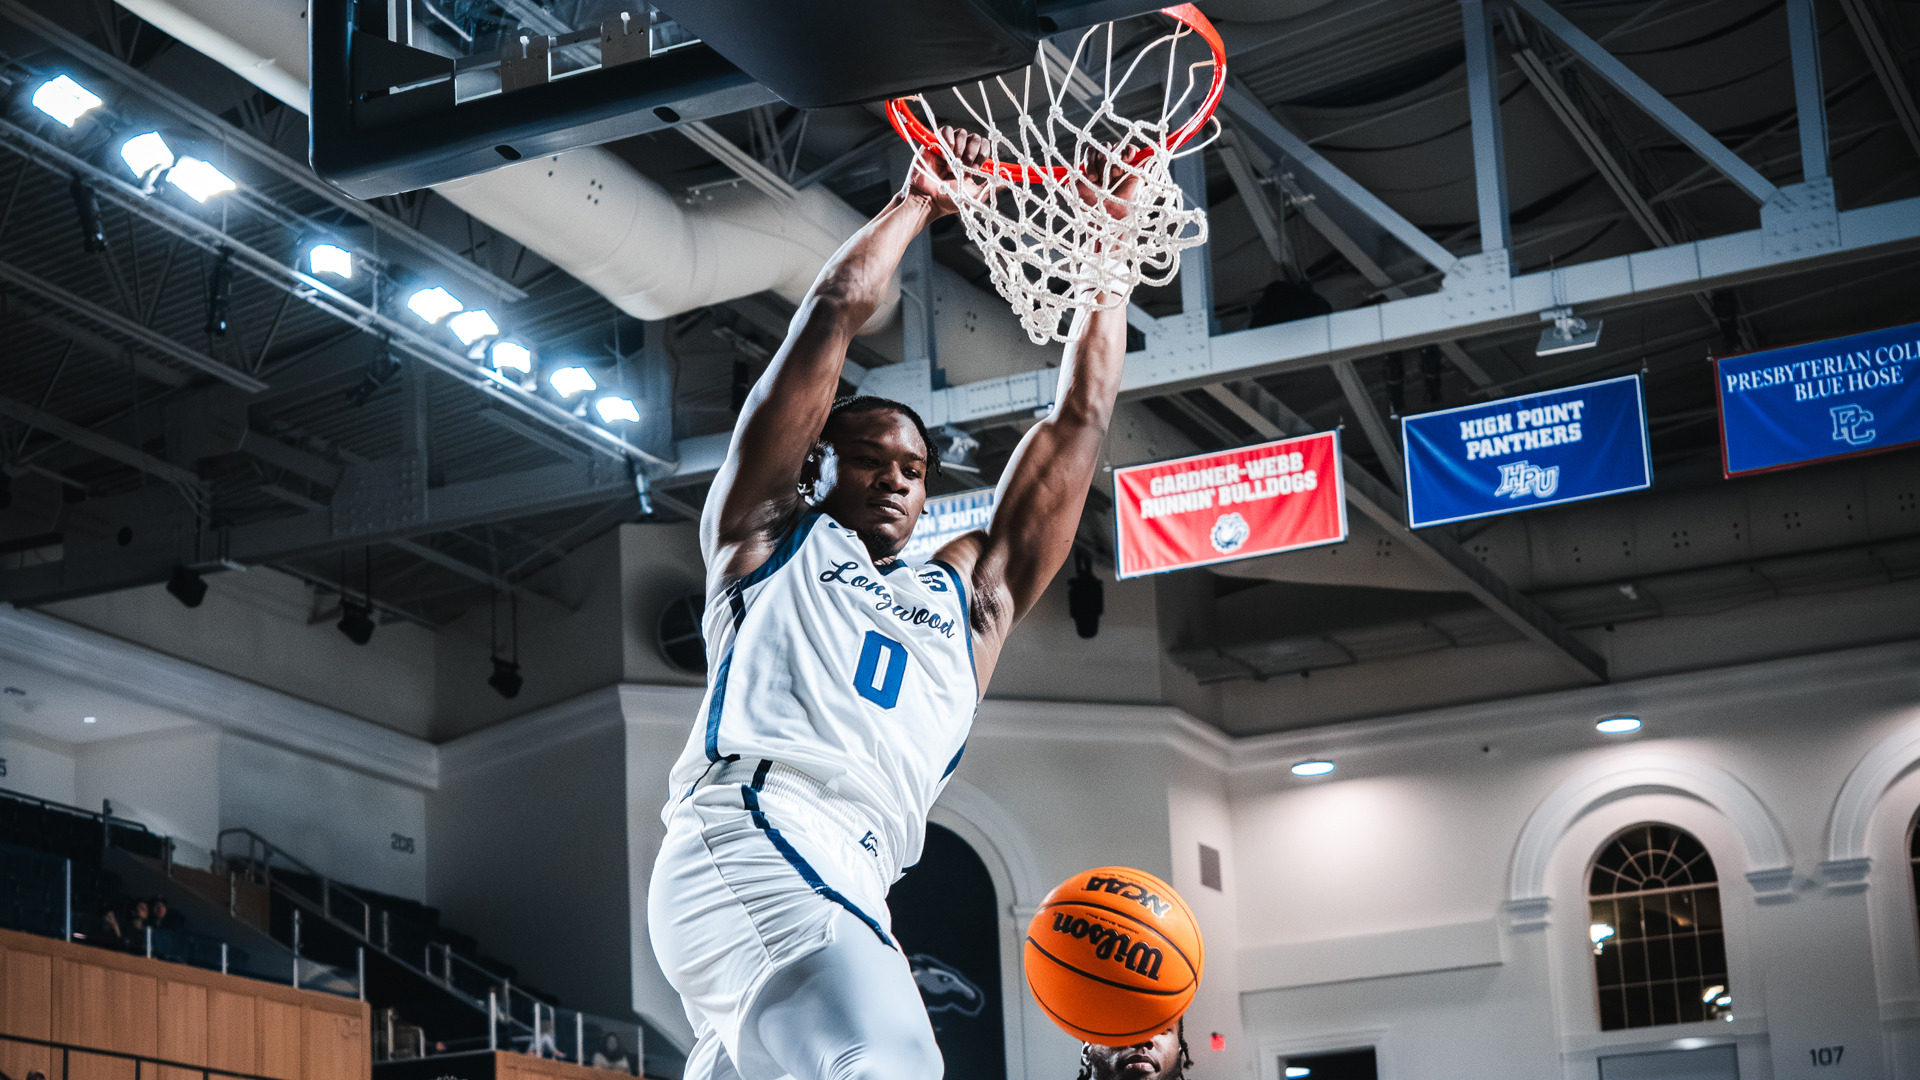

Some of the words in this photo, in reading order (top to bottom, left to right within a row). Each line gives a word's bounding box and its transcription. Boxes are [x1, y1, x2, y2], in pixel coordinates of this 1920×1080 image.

[1726, 350, 1871, 393] PRESBYTERIAN
[1794, 376, 1845, 402] BLUE
[1848, 365, 1904, 392] HOSE
[1460, 413, 1513, 440] HIGH
[1516, 400, 1584, 430] POINT
[1466, 422, 1582, 460] PANTHERS
[1140, 488, 1216, 518] RUNNIN'
[1219, 470, 1318, 506] BULLDOGS
[1150, 452, 1303, 496] GARDNER-WEBB
[1494, 460, 1560, 499] HPU
[913, 514, 936, 535] ON
[820, 559, 955, 638] Longwood
[853, 630, 908, 710] 0
[1085, 876, 1173, 919] NCAA
[1052, 912, 1163, 982] Wilson
[1810, 1046, 1844, 1067] 107
